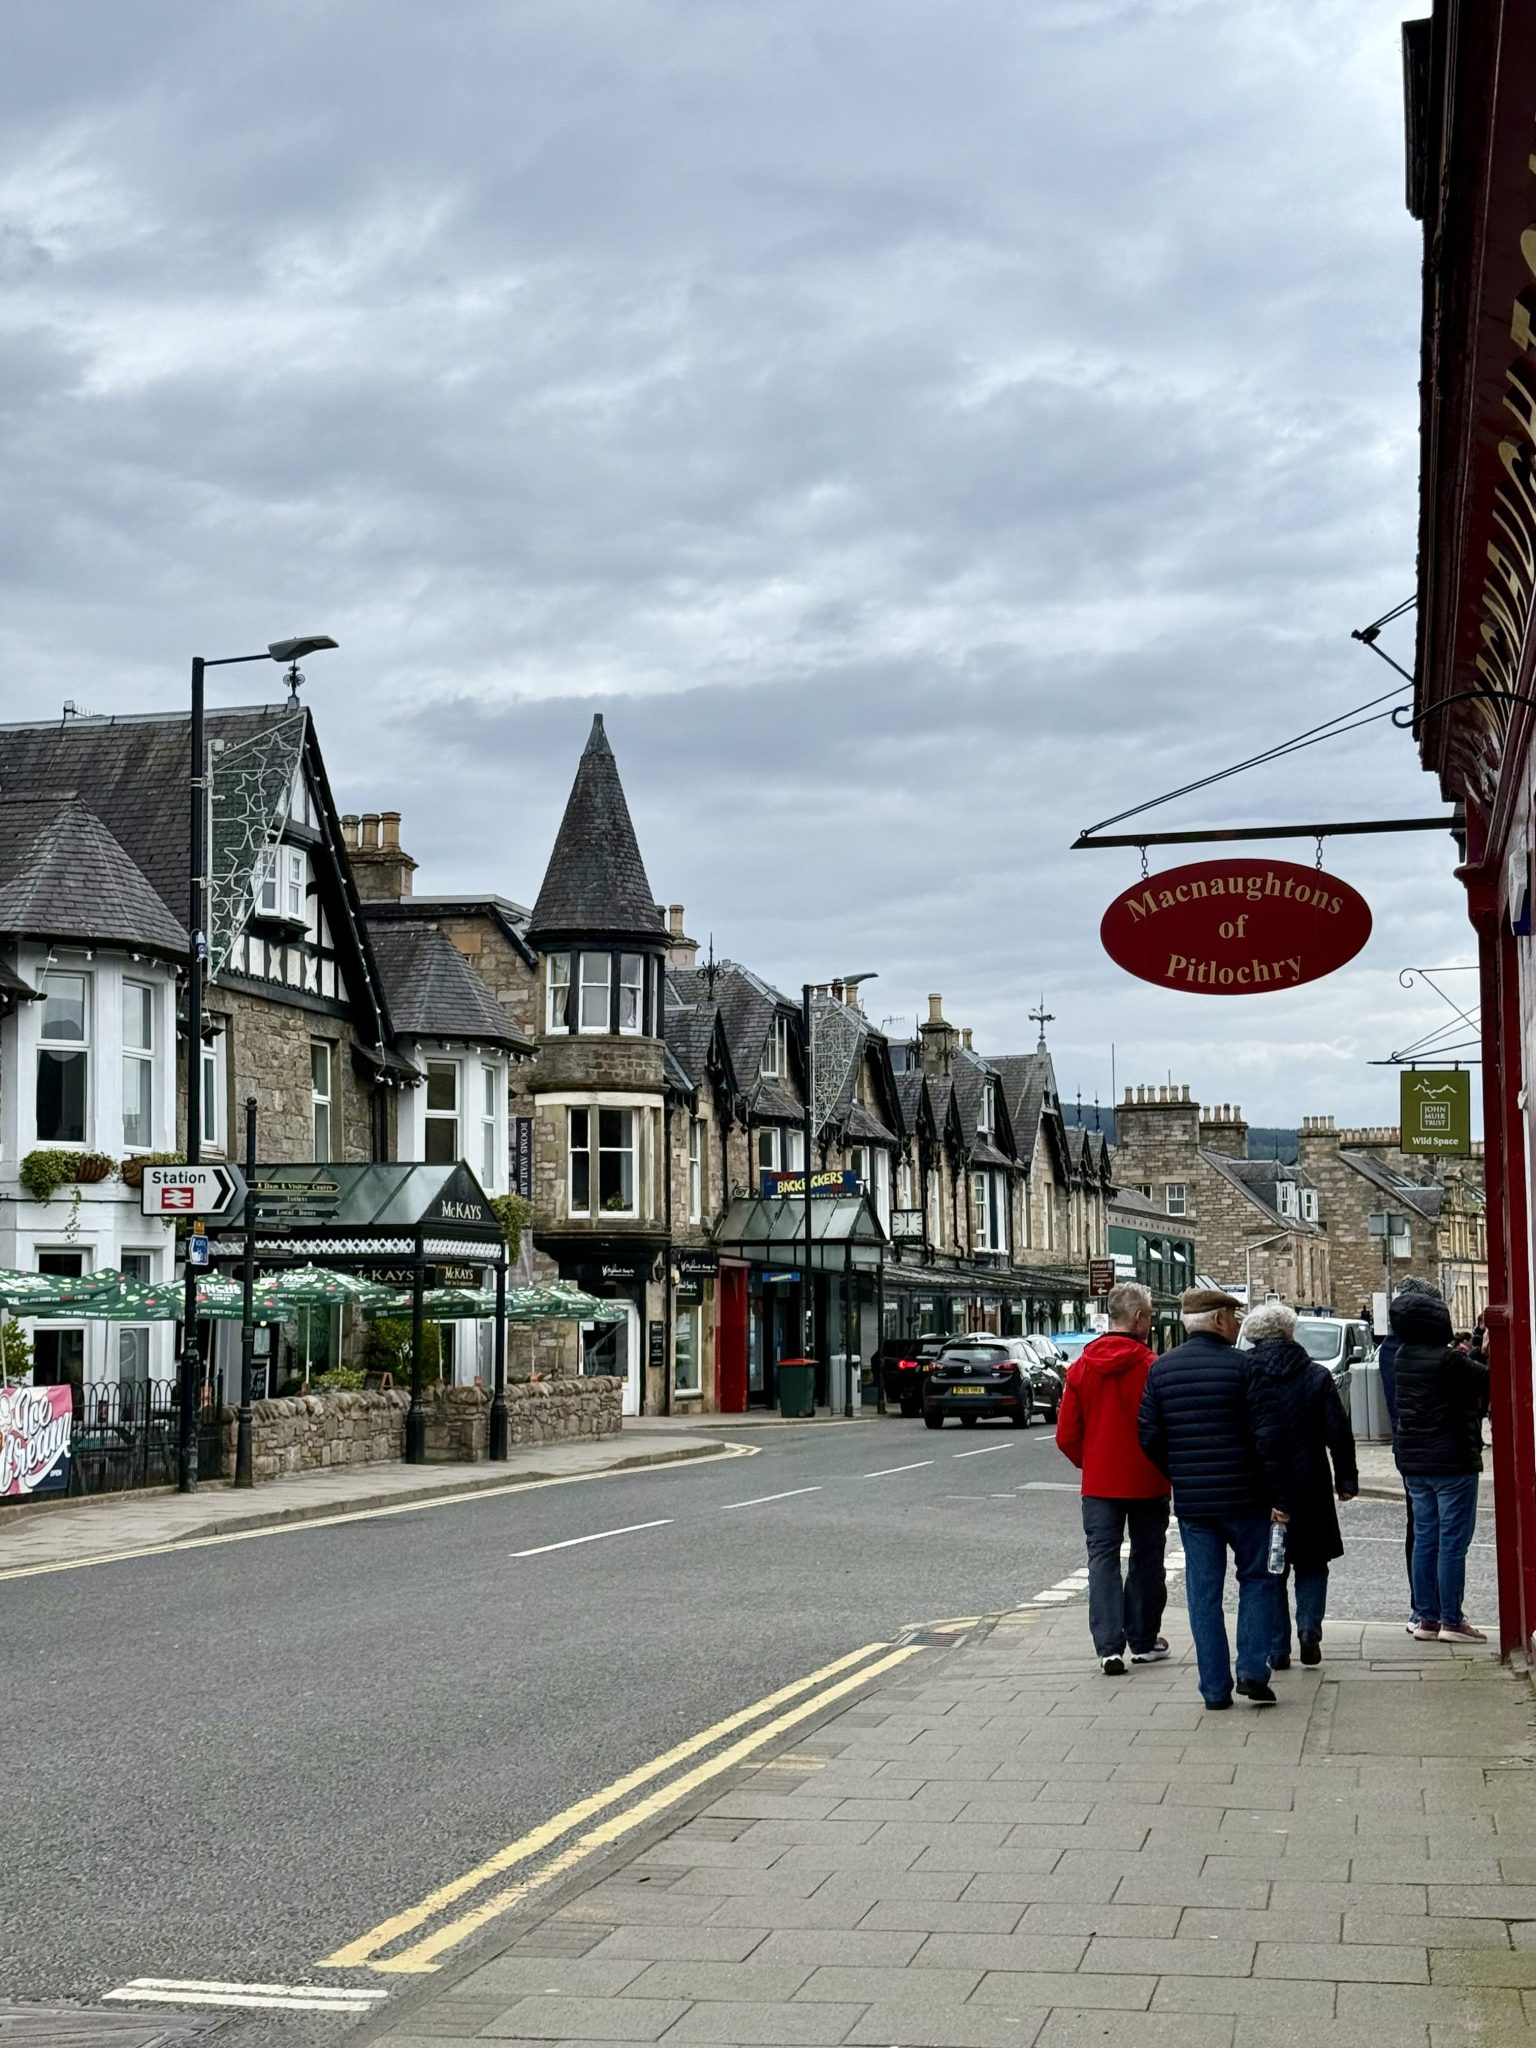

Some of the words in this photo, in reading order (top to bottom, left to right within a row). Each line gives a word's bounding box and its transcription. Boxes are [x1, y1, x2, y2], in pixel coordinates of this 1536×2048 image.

[1124, 871, 1344, 923] Macnaughtons
[1218, 914, 1249, 939] of
[1164, 953, 1302, 985] Pitlochry
[520, 1122, 529, 1154] ROOMS
[1412, 1137, 1432, 1145] Wild
[1433, 1137, 1459, 1147] Space
[152, 1171, 206, 1184] Station
[777, 1171, 844, 1194] BACKCKERS
[441, 1200, 482, 1220] McKAYS
[445, 1266, 474, 1280] McKAYS
[15, 1388, 53, 1441] Ice
